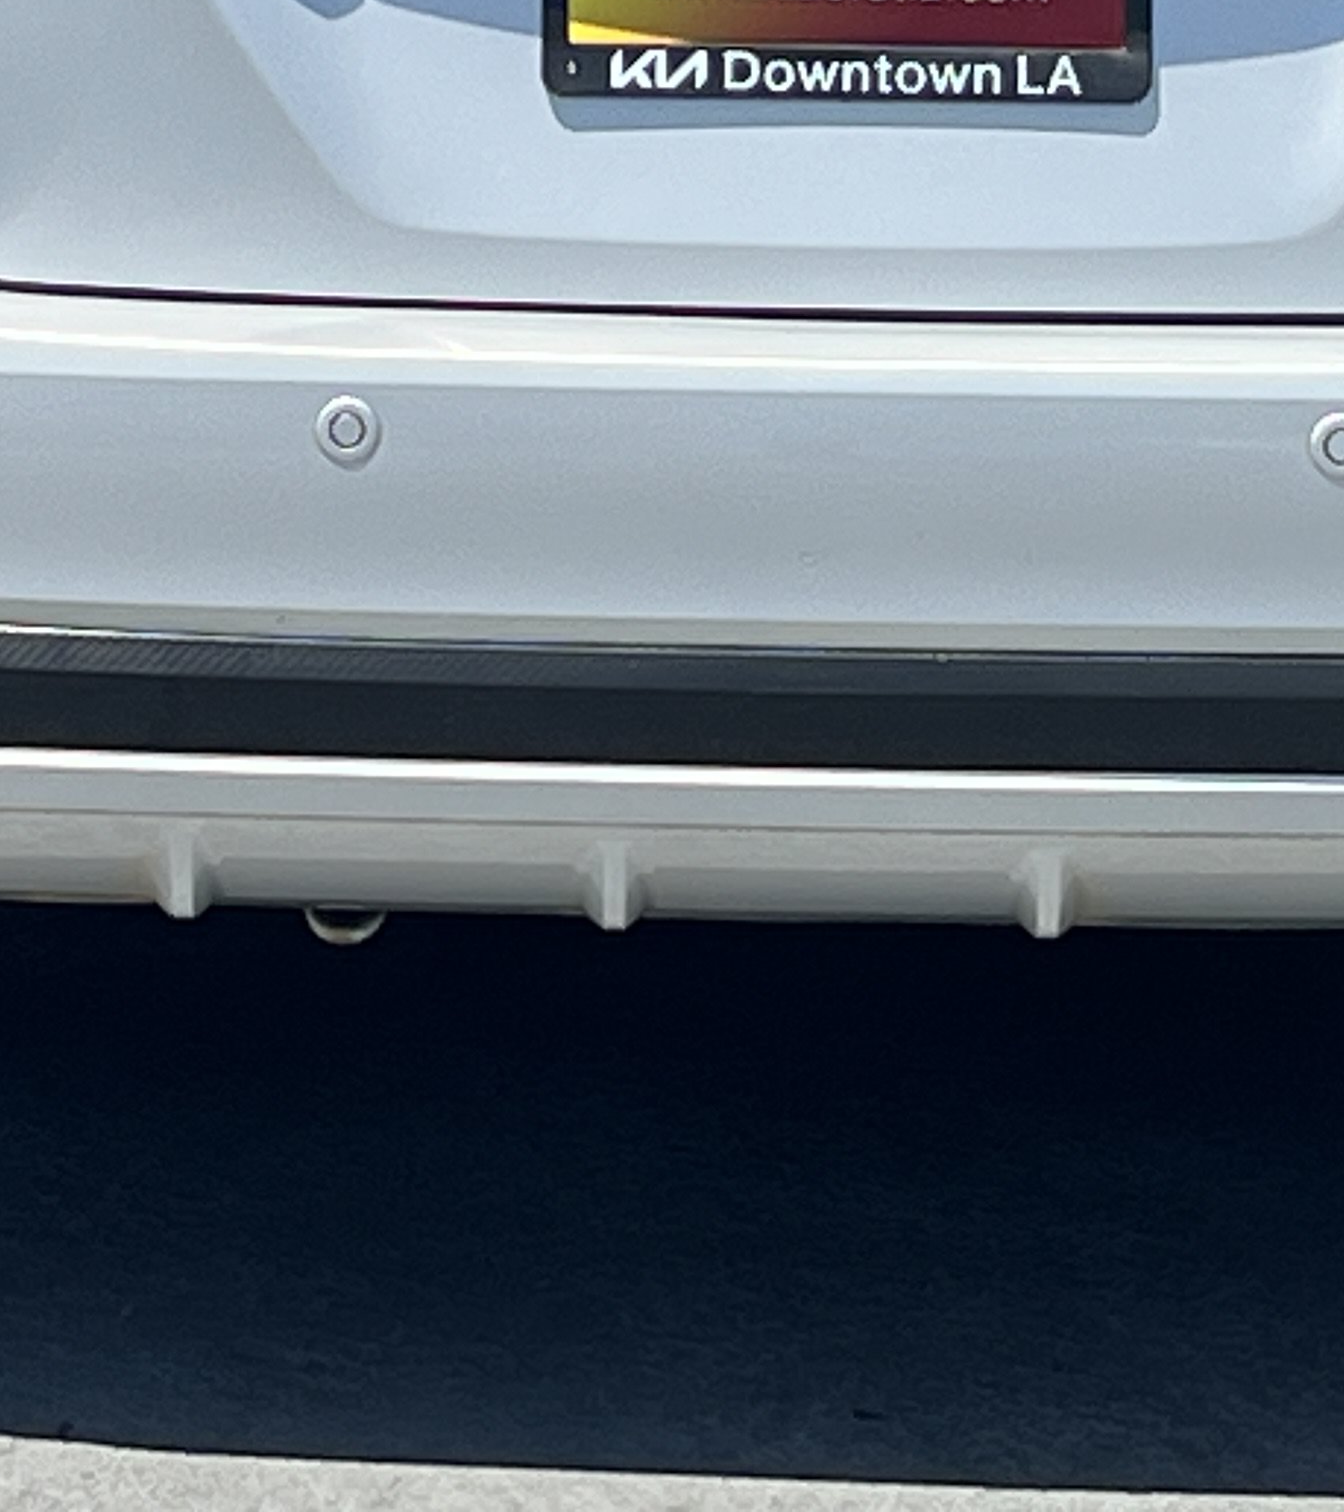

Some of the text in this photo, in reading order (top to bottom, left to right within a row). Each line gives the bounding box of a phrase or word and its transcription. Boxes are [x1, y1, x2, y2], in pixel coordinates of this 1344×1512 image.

[609, 49, 1083, 96] KIA Downtown LA
